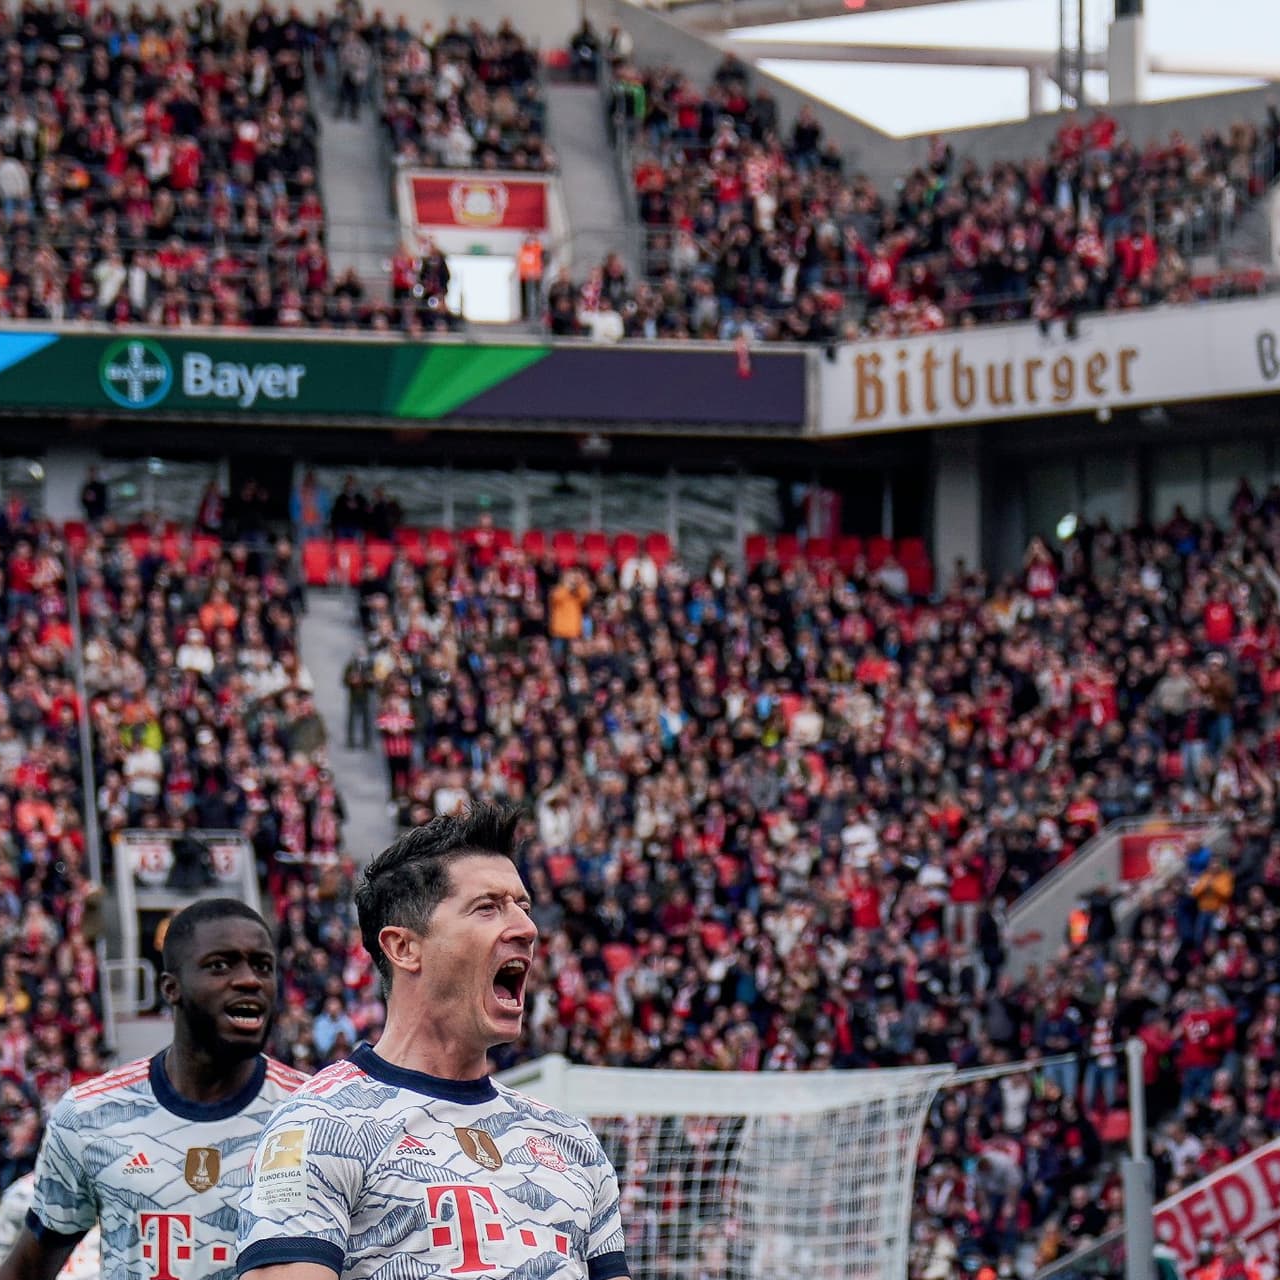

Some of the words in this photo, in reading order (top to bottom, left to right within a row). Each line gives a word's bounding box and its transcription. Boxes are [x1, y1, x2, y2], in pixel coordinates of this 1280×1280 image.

[181, 351, 306, 409] Bayer
[852, 346, 1140, 423] Bitburger
[259, 1170, 302, 1183] BUNDESLIGA
[396, 1145, 436, 1156] adidas
[1153, 1173, 1256, 1261] RED
